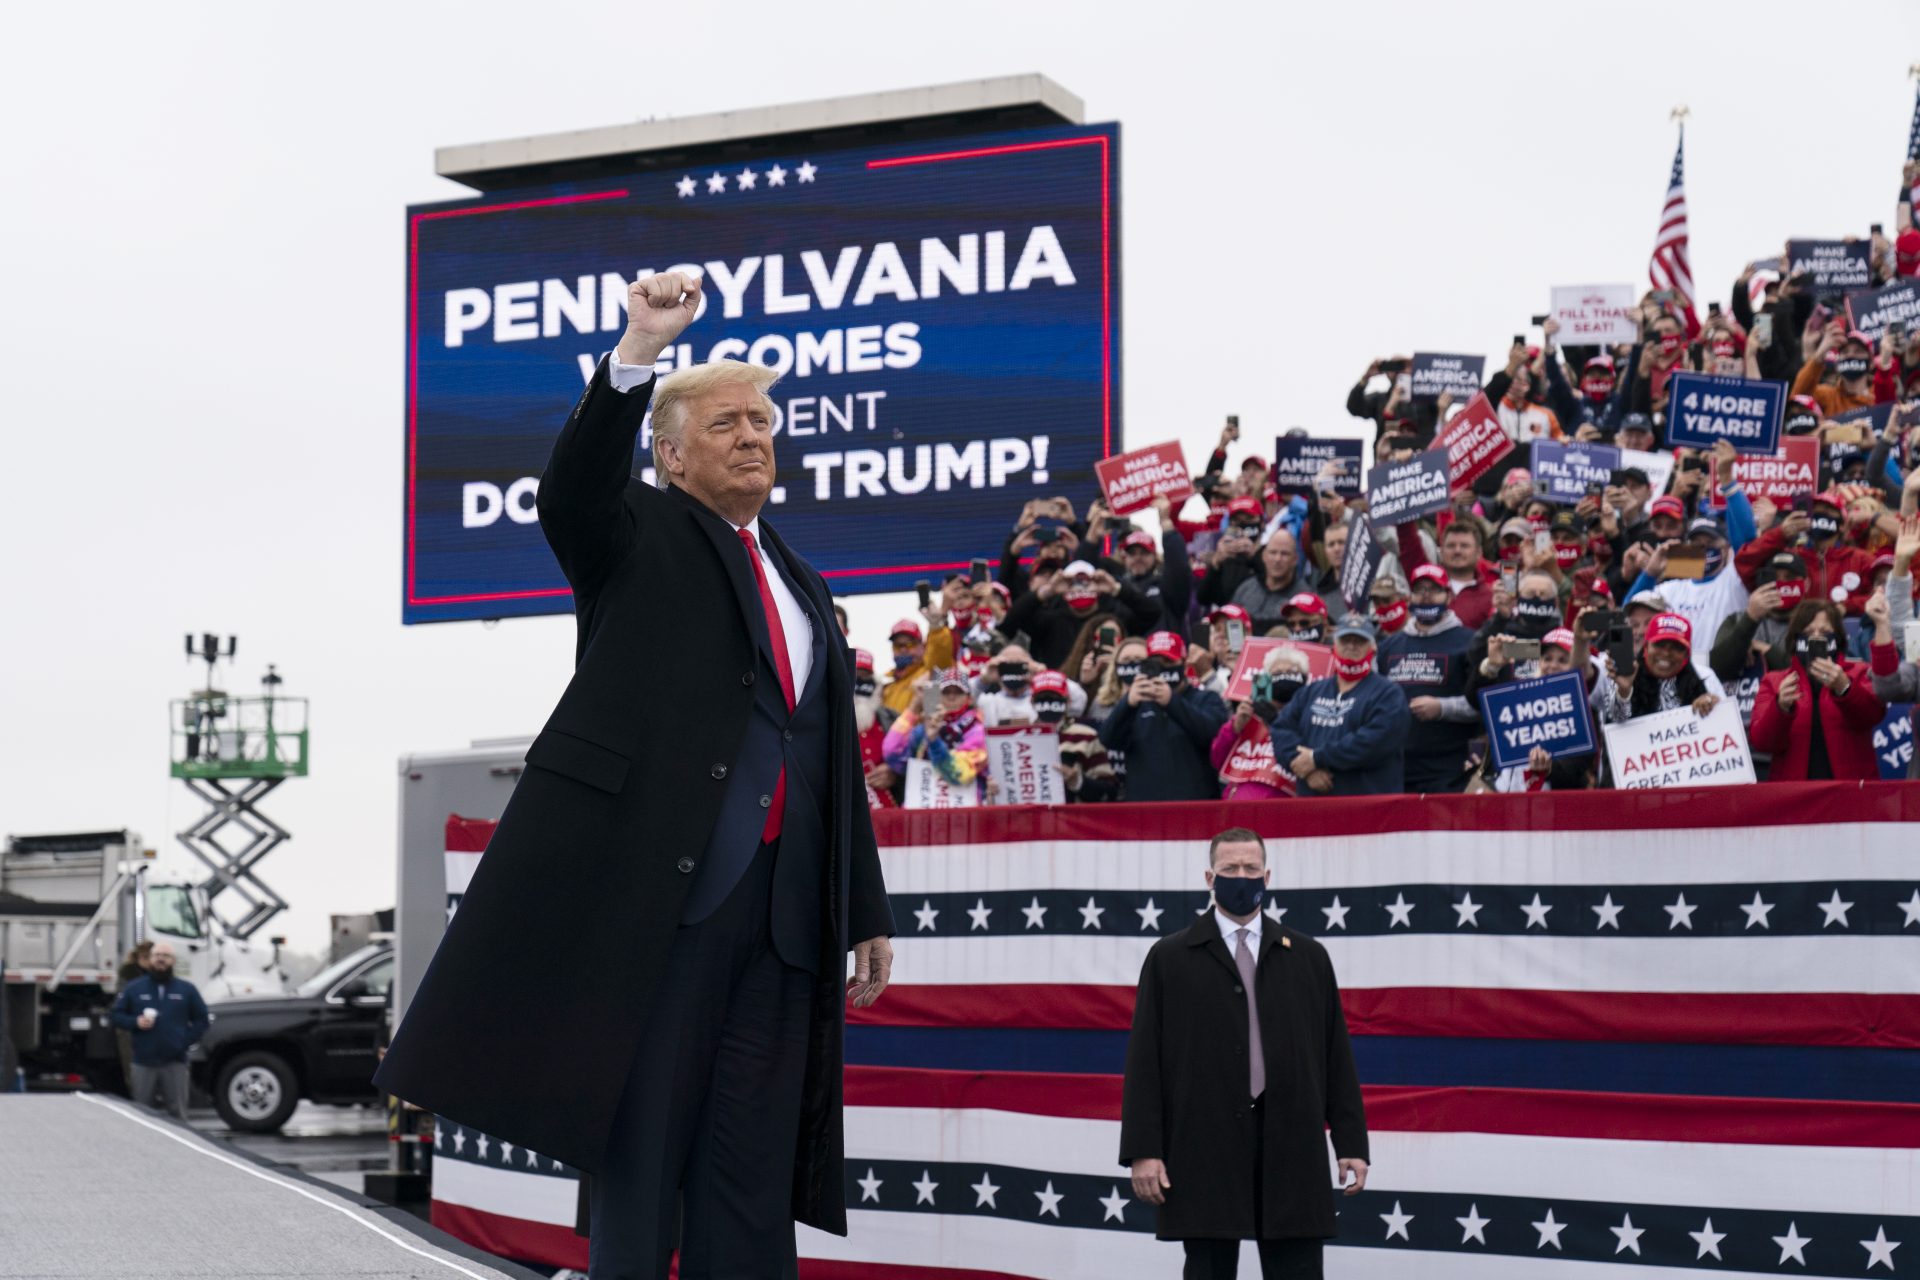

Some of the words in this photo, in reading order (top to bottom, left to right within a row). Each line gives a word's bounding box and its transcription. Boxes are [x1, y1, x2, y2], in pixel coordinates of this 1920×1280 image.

[1813, 246, 1847, 257] MAKE
[1792, 257, 1868, 273] AMERICA
[1832, 273, 1868, 284] AGAIN
[1877, 288, 1916, 308] MAKE
[1559, 308, 1587, 319] FILL
[1574, 321, 1615, 333] SEAT!
[1432, 359, 1462, 370] MAKE
[1413, 369, 1480, 386] AMERICA
[1683, 392, 1698, 410] 4
[1703, 394, 1767, 417] MORE
[1444, 419, 1473, 446] MAKE
[1683, 413, 1762, 438] YEARS!
[1301, 446, 1336, 459] MAKE
[1472, 431, 1505, 464] AGAIN
[802, 435, 1050, 500] TRUMP!
[1124, 453, 1160, 473] MAKE
[1388, 461, 1423, 481] MAKE
[1538, 461, 1571, 478] FILL
[1732, 462, 1814, 481] MERICA
[1109, 461, 1186, 496] AMERICA
[1370, 469, 1447, 506] AMERICA
[1111, 487, 1151, 510] GREAT
[1153, 477, 1189, 495] AGAIN
[1370, 500, 1408, 520] GREAT
[1408, 487, 1448, 508] AGAIN
[1498, 706, 1514, 725] 4
[1516, 693, 1575, 720] MORE
[1504, 717, 1577, 749] YEARS!
[1649, 720, 1700, 744] MAKE
[1873, 729, 1889, 749] 4
[1000, 741, 1015, 784] GREAT
[1623, 733, 1739, 776] AMERICA
[1017, 741, 1037, 804] AMERI
[1626, 768, 1682, 790] GREAT
[1689, 756, 1745, 779] AGAIN
